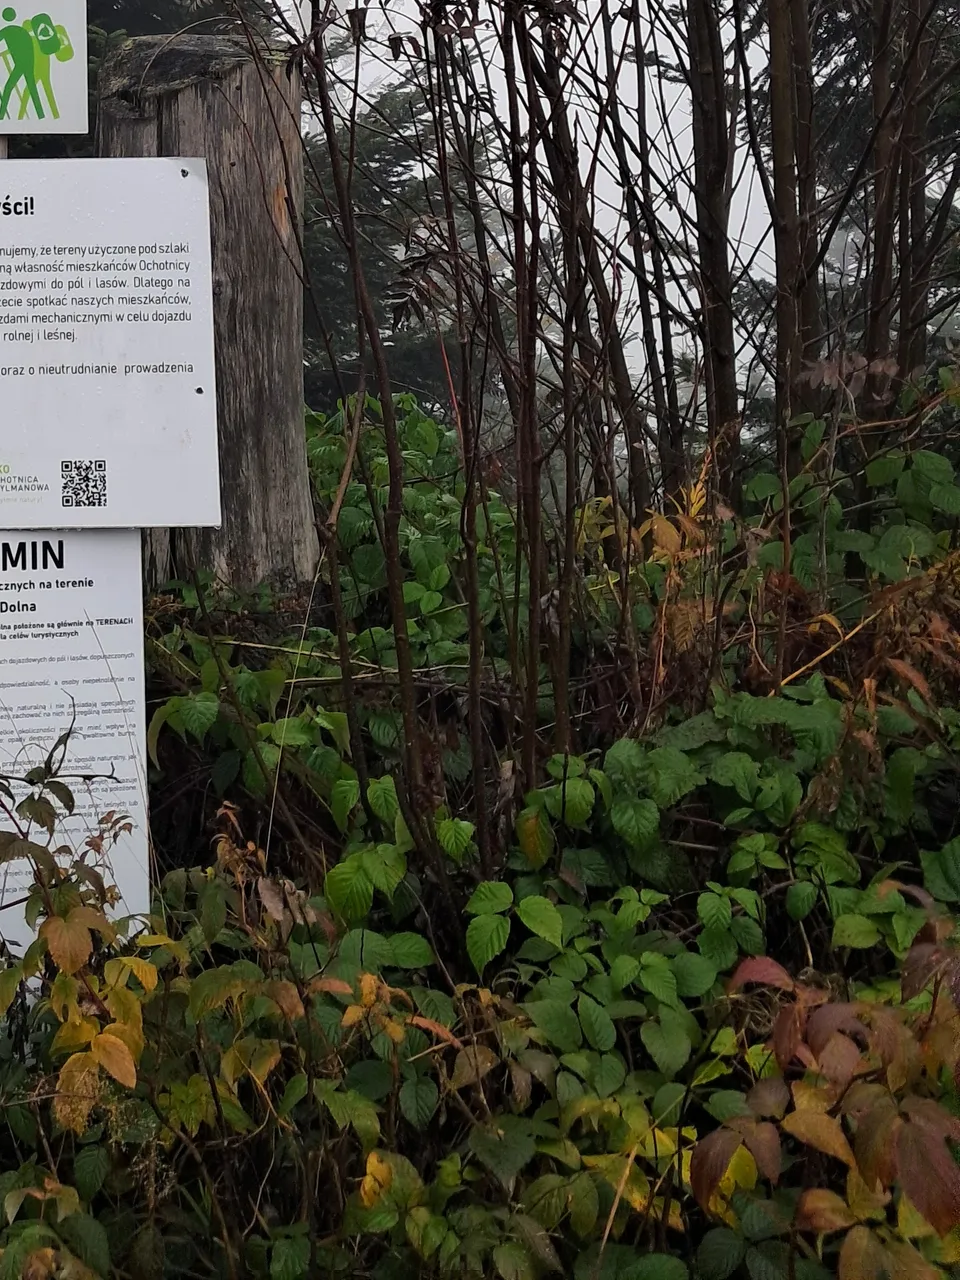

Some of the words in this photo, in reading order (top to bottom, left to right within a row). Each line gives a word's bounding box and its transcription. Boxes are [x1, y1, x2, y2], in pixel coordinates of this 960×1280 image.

[40, 245, 52, 256] że
[53, 245, 87, 257] tereny
[138, 243, 157, 255] pod
[14, 260, 65, 273] własność
[65, 259, 137, 272] mieszkańców
[139, 260, 191, 273] Ochotnicy
[51, 278, 64, 290] do
[67, 277, 84, 291] pól
[133, 276, 174, 290] Dlatego
[177, 278, 191, 287] na
[26, 293, 68, 308] spotkać
[71, 294, 114, 307] naszych
[117, 292, 191, 306] mieszkańców,
[31, 312, 113, 325] mechanicznymi
[115, 313, 125, 322] w
[126, 310, 150, 322] celu
[151, 309, 191, 323] dojazdu
[3, 329, 34, 343] rolnej
[0, 365, 25, 376] oraz
[28, 365, 35, 375] o
[124, 362, 194, 375] prowadzenia
[39, 579, 54, 590] na
[55, 577, 94, 589] terenie
[0, 600, 37, 614] Dolna
[13, 621, 45, 631] położone
[47, 621, 55, 629] są
[57, 620, 83, 629] głównie
[96, 617, 133, 626] TERENACH
[8, 632, 29, 640] celów
[31, 630, 79, 639] turystycznych
